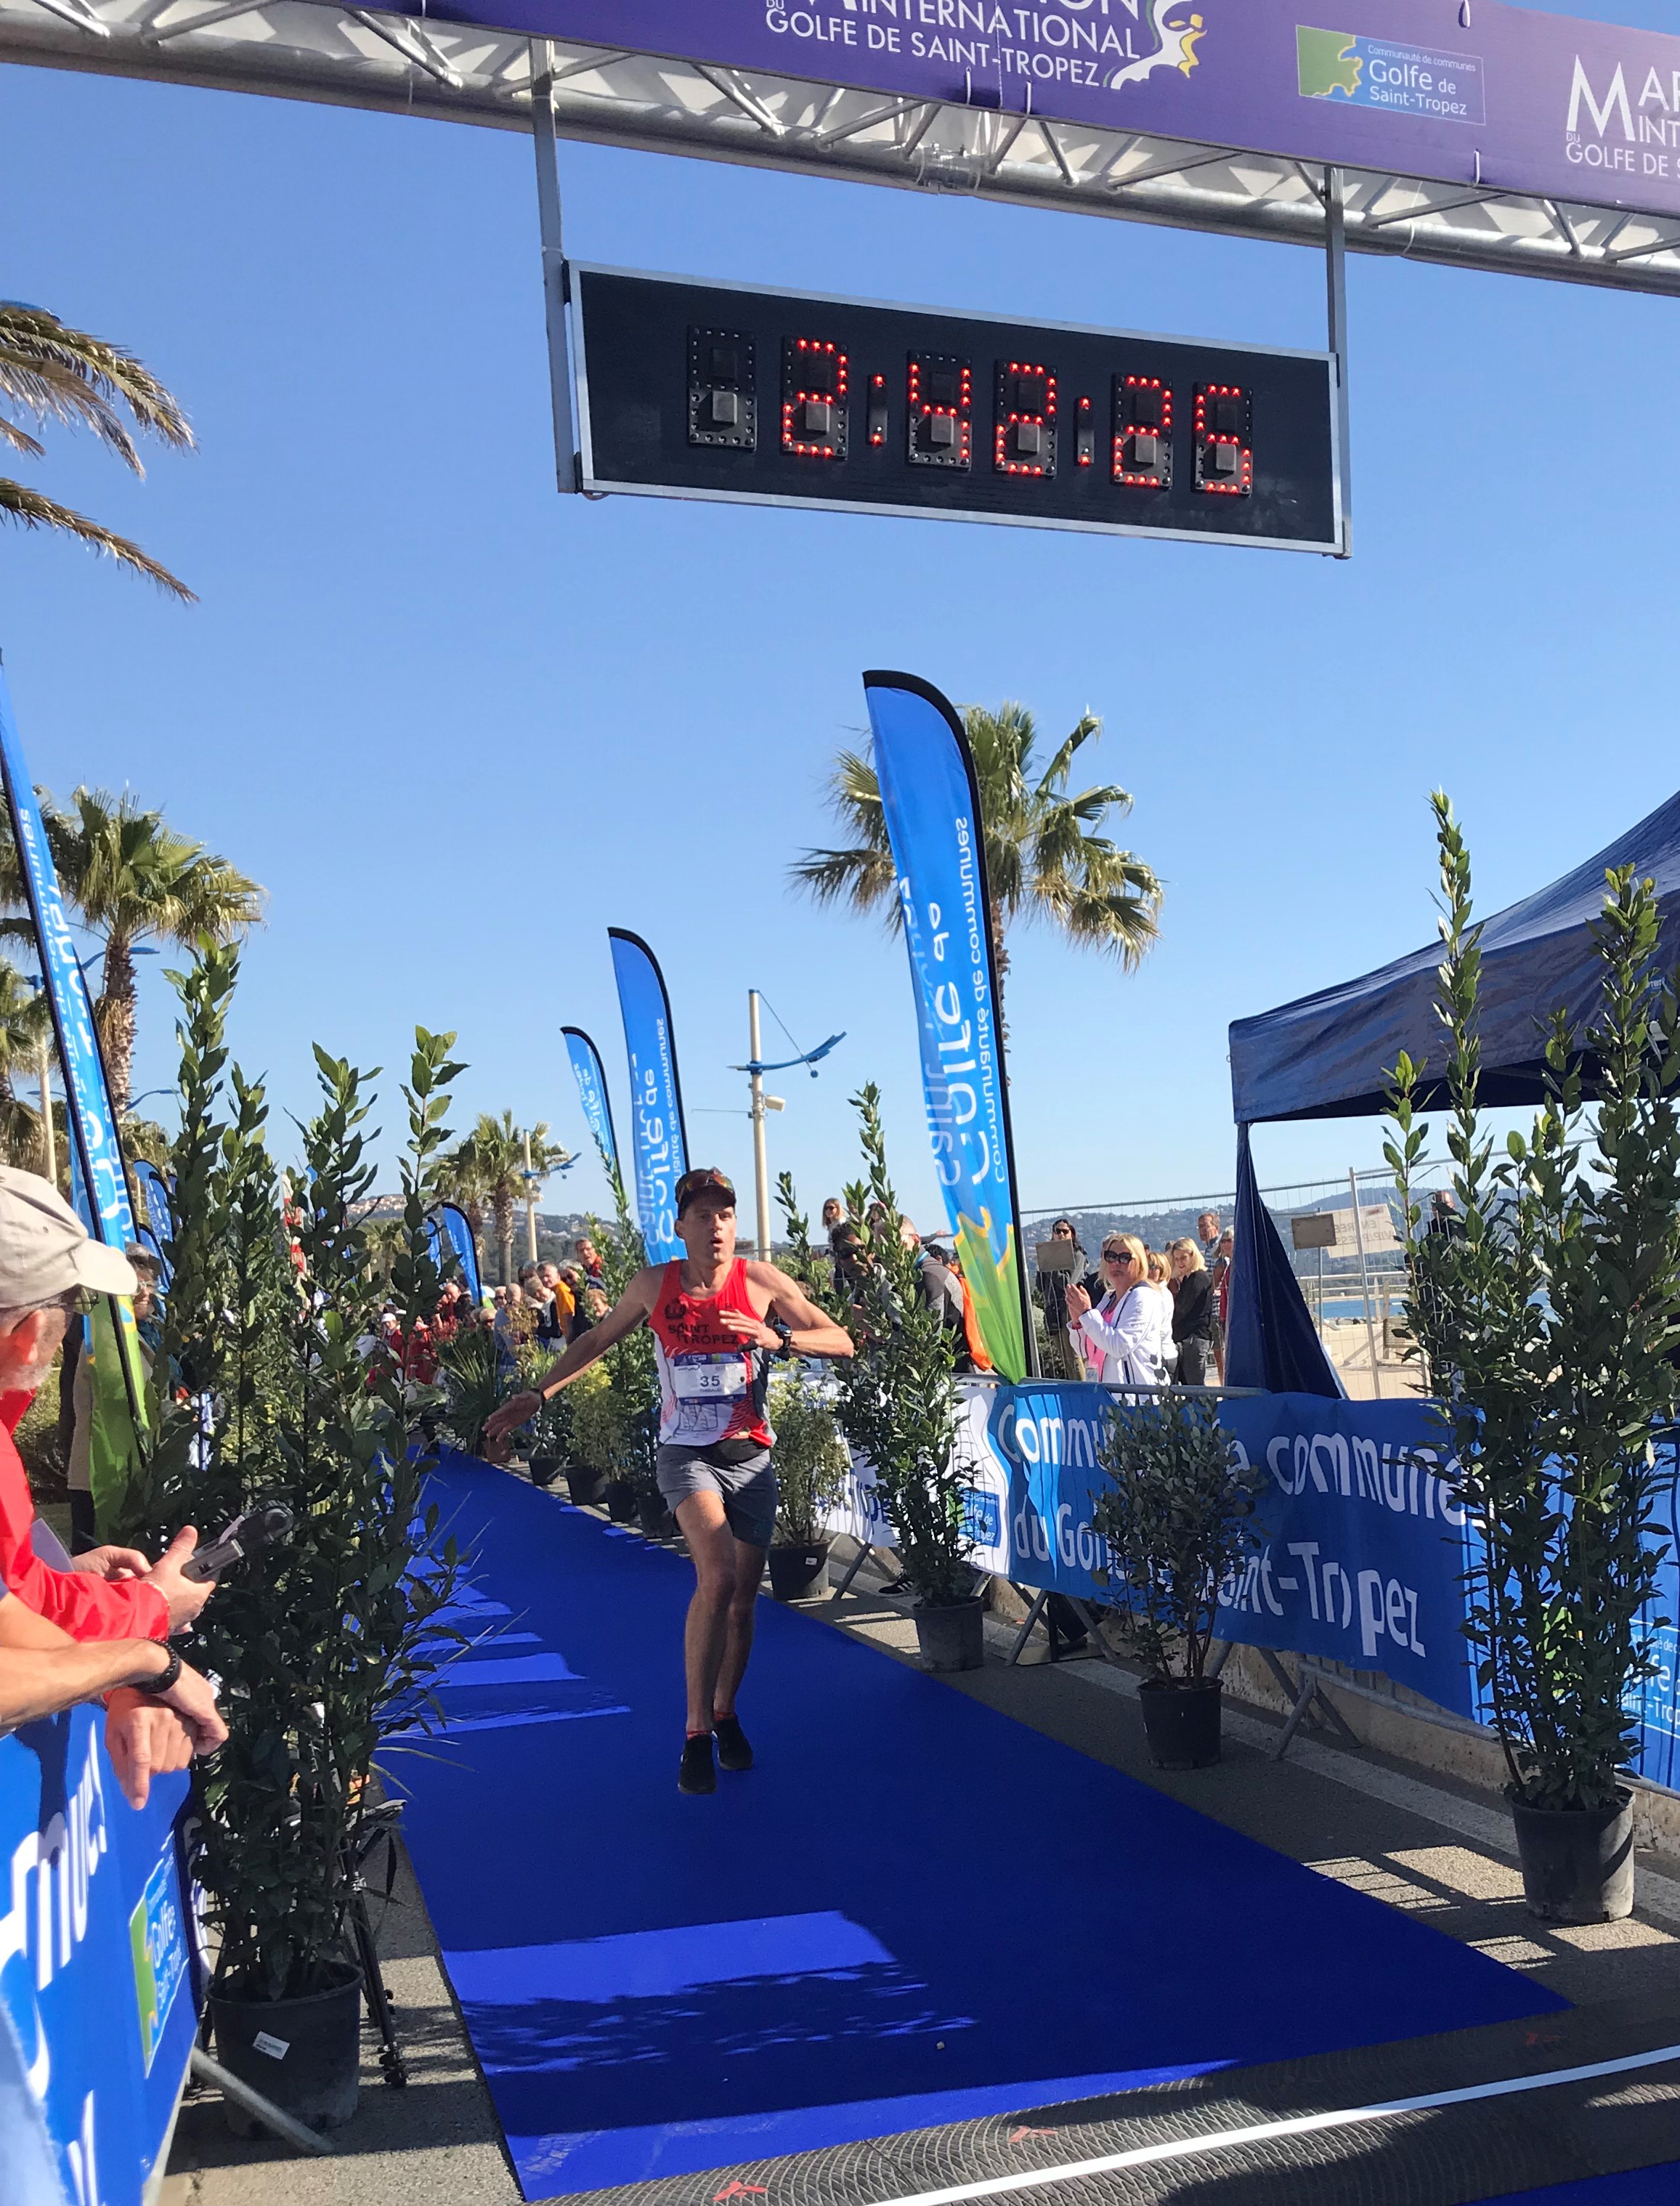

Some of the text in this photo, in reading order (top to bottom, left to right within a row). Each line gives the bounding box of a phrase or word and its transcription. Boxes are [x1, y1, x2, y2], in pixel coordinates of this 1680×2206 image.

[766, 8, 858, 46] GOLFE
[867, 24, 901, 53] DE
[911, 32, 1100, 86] SAINT-TROPEZ
[1368, 44, 1477, 72] Communauté de communes
[1369, 59, 1457, 94] Golfe de
[1370, 86, 1468, 115] Saint-Tropez
[1566, 132, 1580, 143] DU
[1566, 142, 1636, 171] GOLFE
[1643, 153, 1669, 177] DE
[700, 1375, 721, 1387] 35
[1014, 1494, 1050, 1562] du
